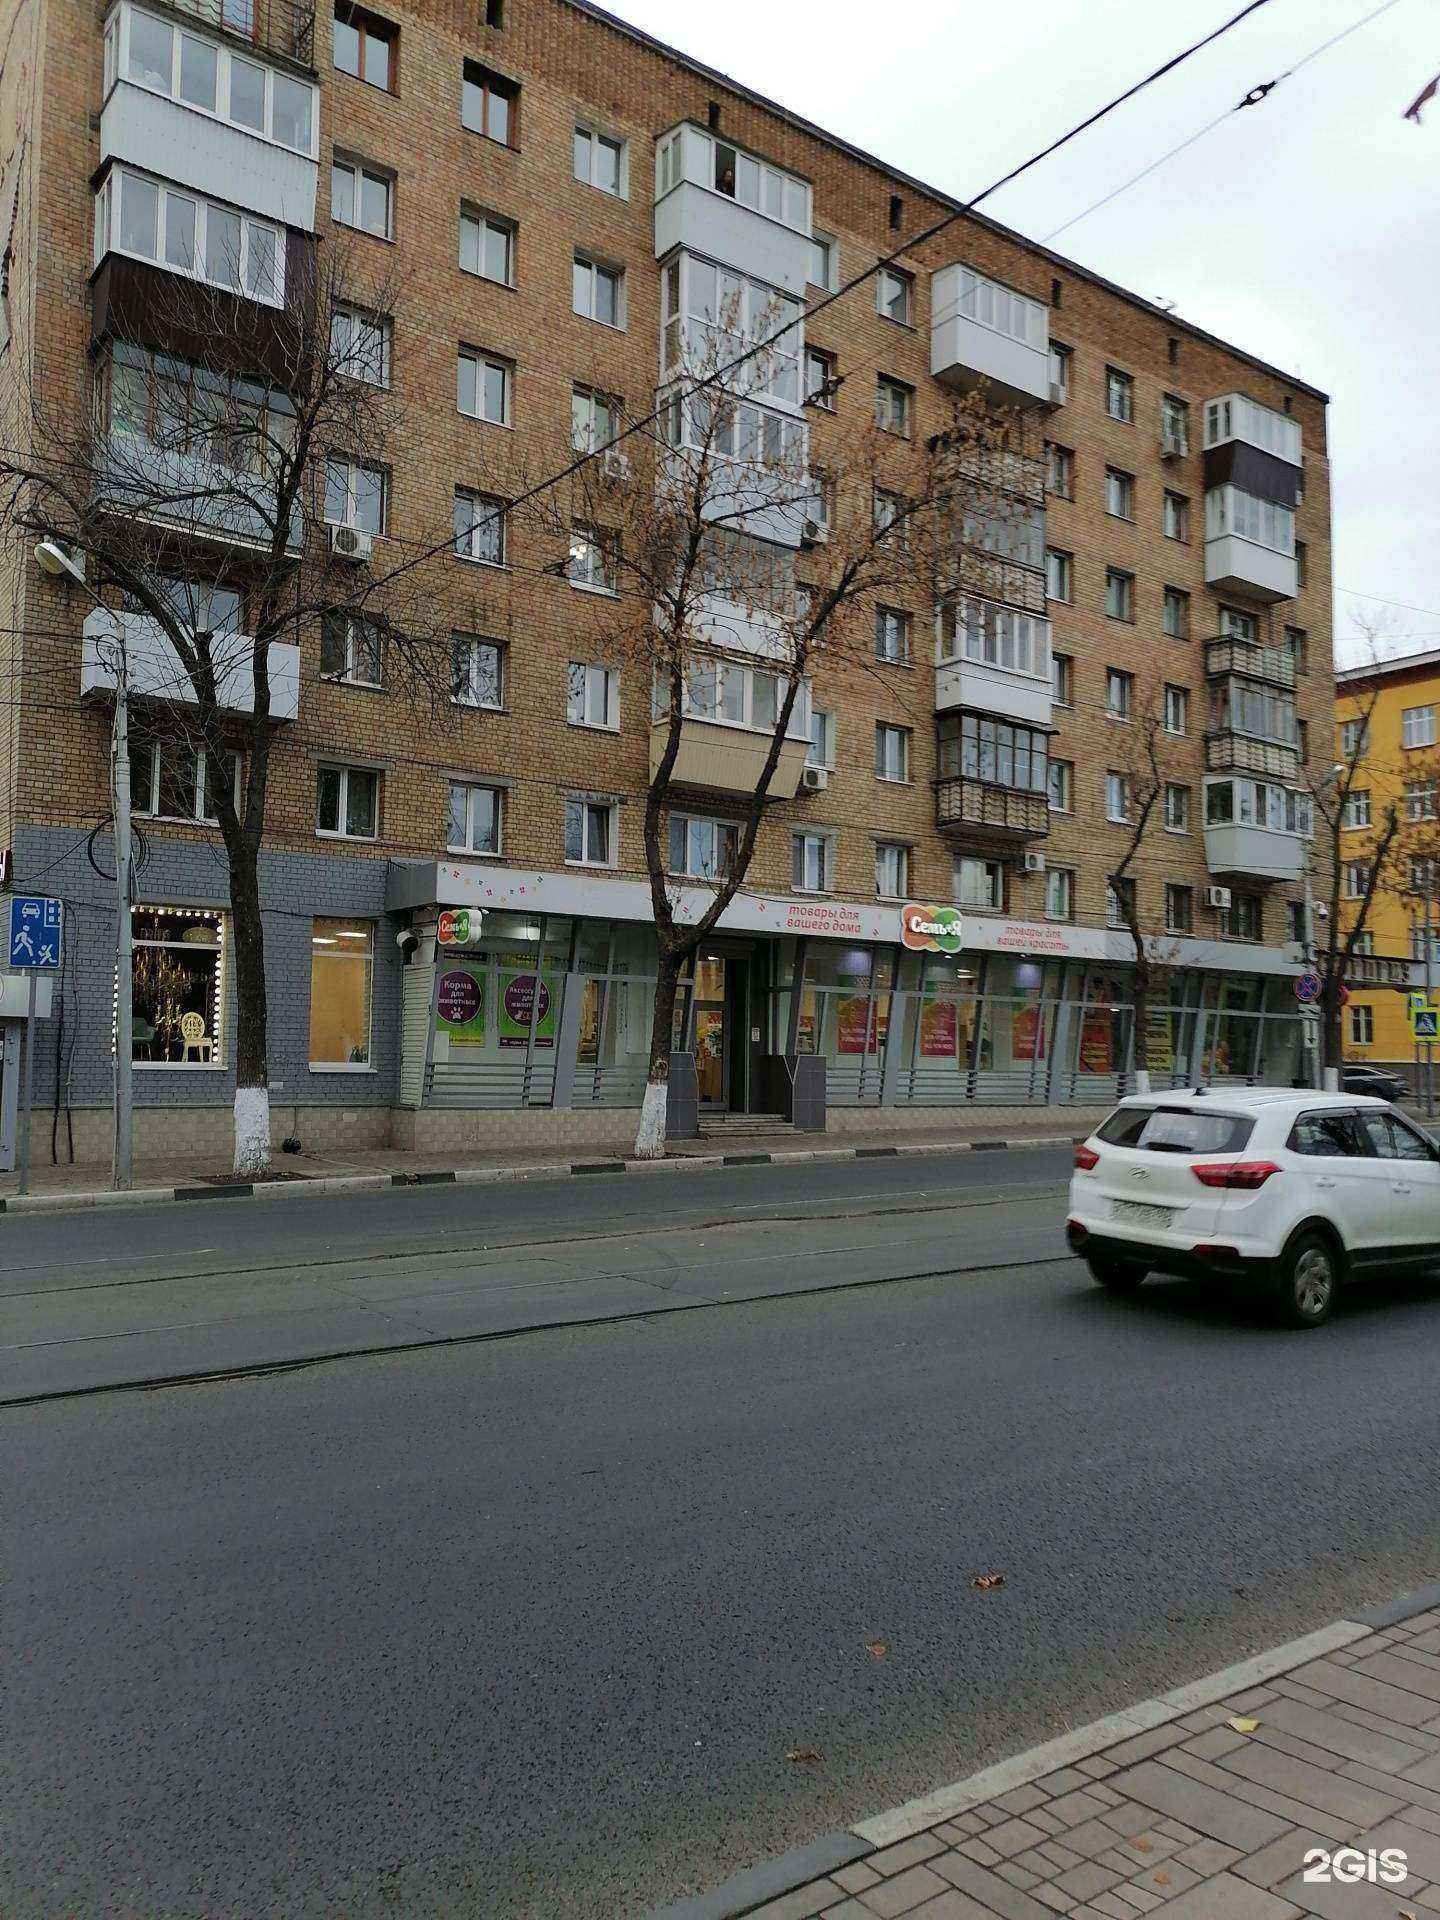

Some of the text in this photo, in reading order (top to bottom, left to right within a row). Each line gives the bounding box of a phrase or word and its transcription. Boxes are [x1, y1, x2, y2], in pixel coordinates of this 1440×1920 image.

[788, 905, 860, 920] товары для
[786, 918, 861, 933] вашего дома
[444, 980, 472, 991] Корма
